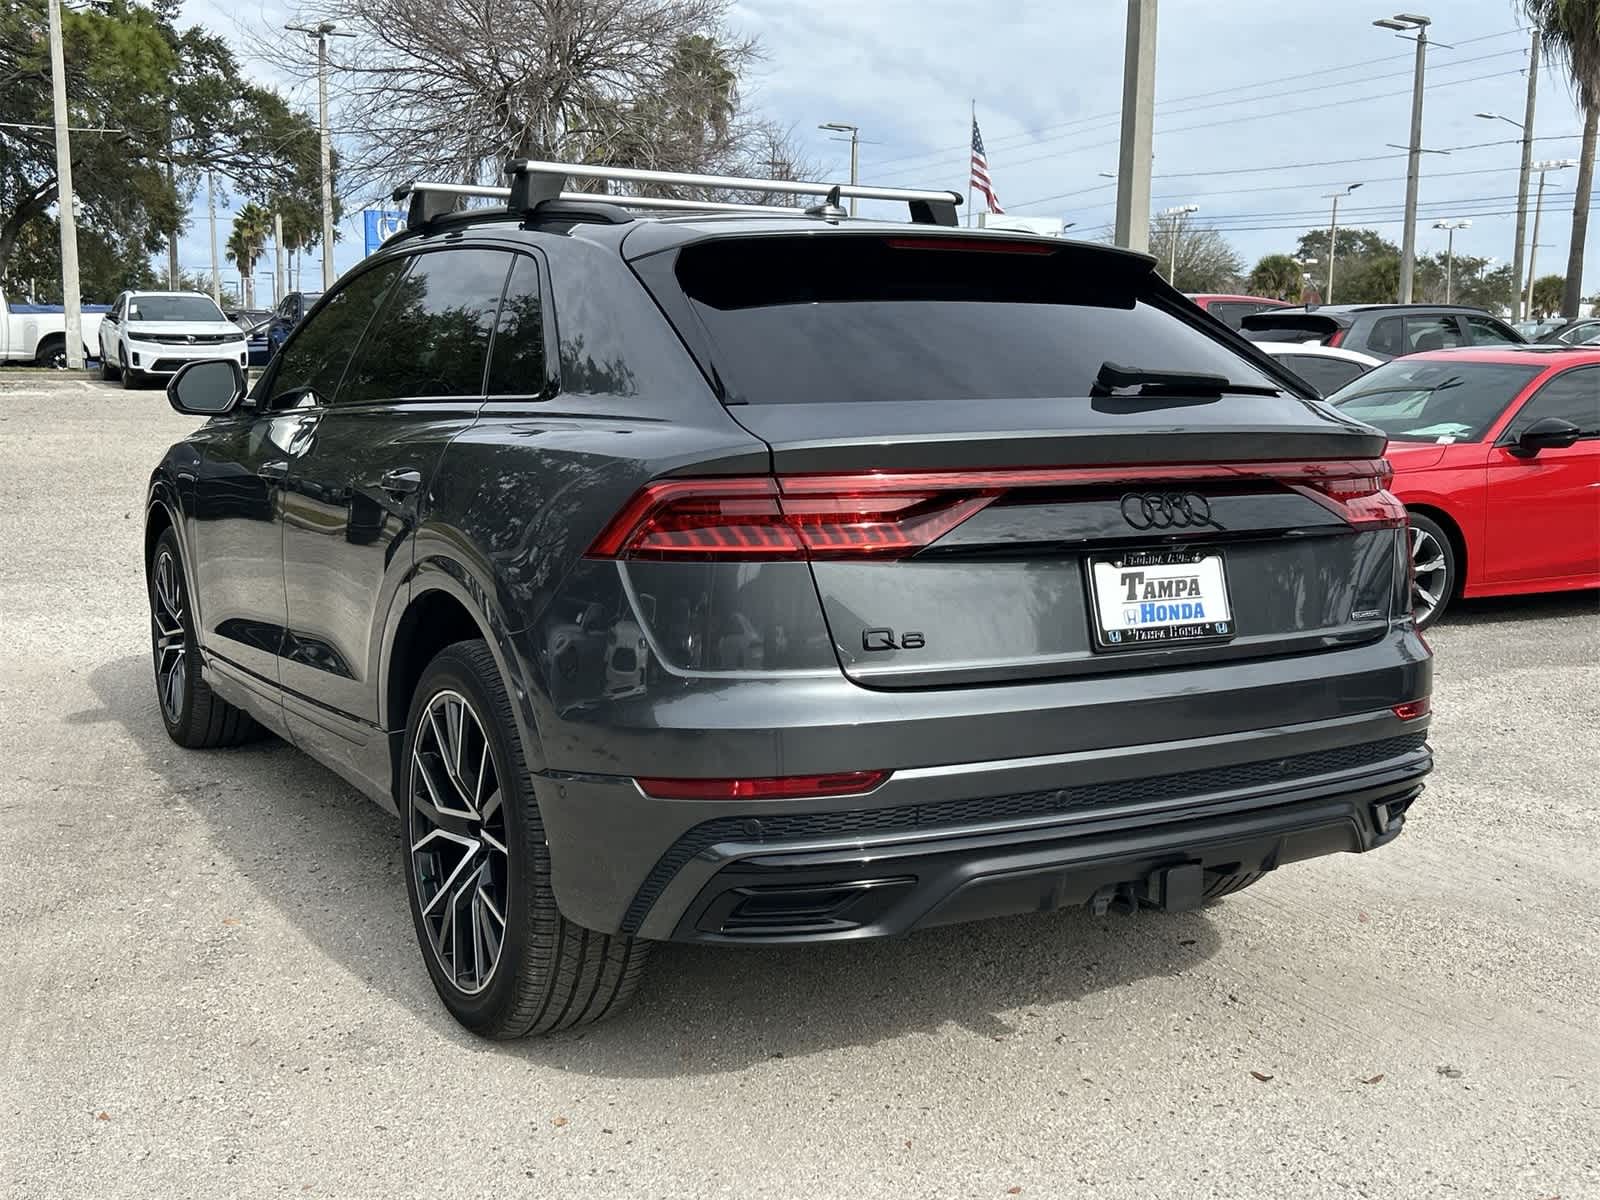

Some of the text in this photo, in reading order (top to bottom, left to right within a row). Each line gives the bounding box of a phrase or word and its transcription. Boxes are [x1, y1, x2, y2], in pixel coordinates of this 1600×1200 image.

[1120, 571, 1201, 601] TAMPA
[1140, 602, 1205, 624] HONDA
[862, 627, 926, 652] Q8
